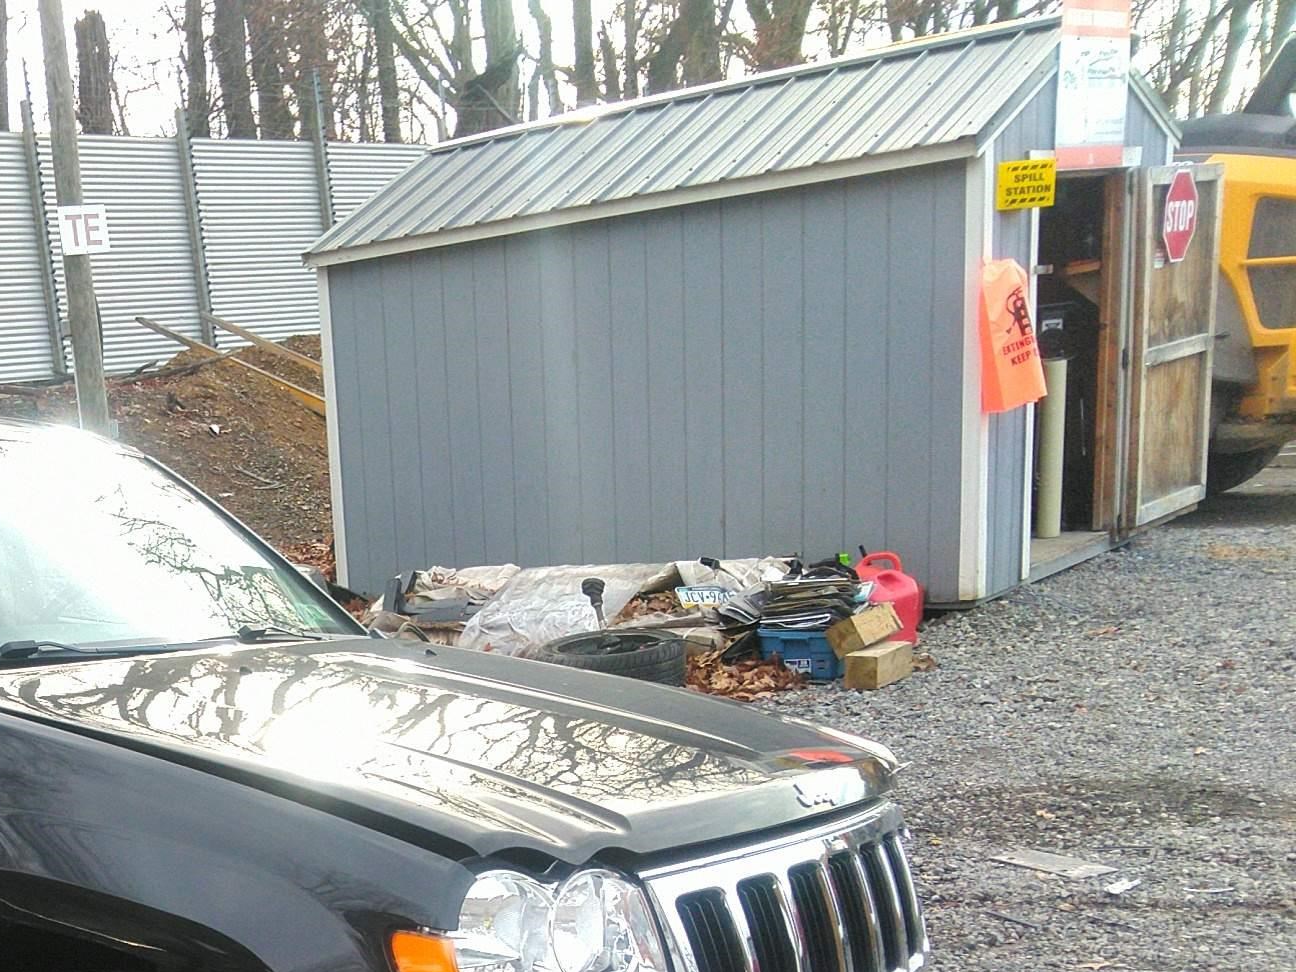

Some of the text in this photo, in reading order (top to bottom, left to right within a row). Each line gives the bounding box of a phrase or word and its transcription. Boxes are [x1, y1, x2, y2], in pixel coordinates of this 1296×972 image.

[1014, 172, 1045, 183] SPILL
[1006, 184, 1051, 196] STATION
[1167, 200, 1194, 233] STOP
[64, 213, 103, 247] TE
[1011, 350, 1032, 366] KEEP
